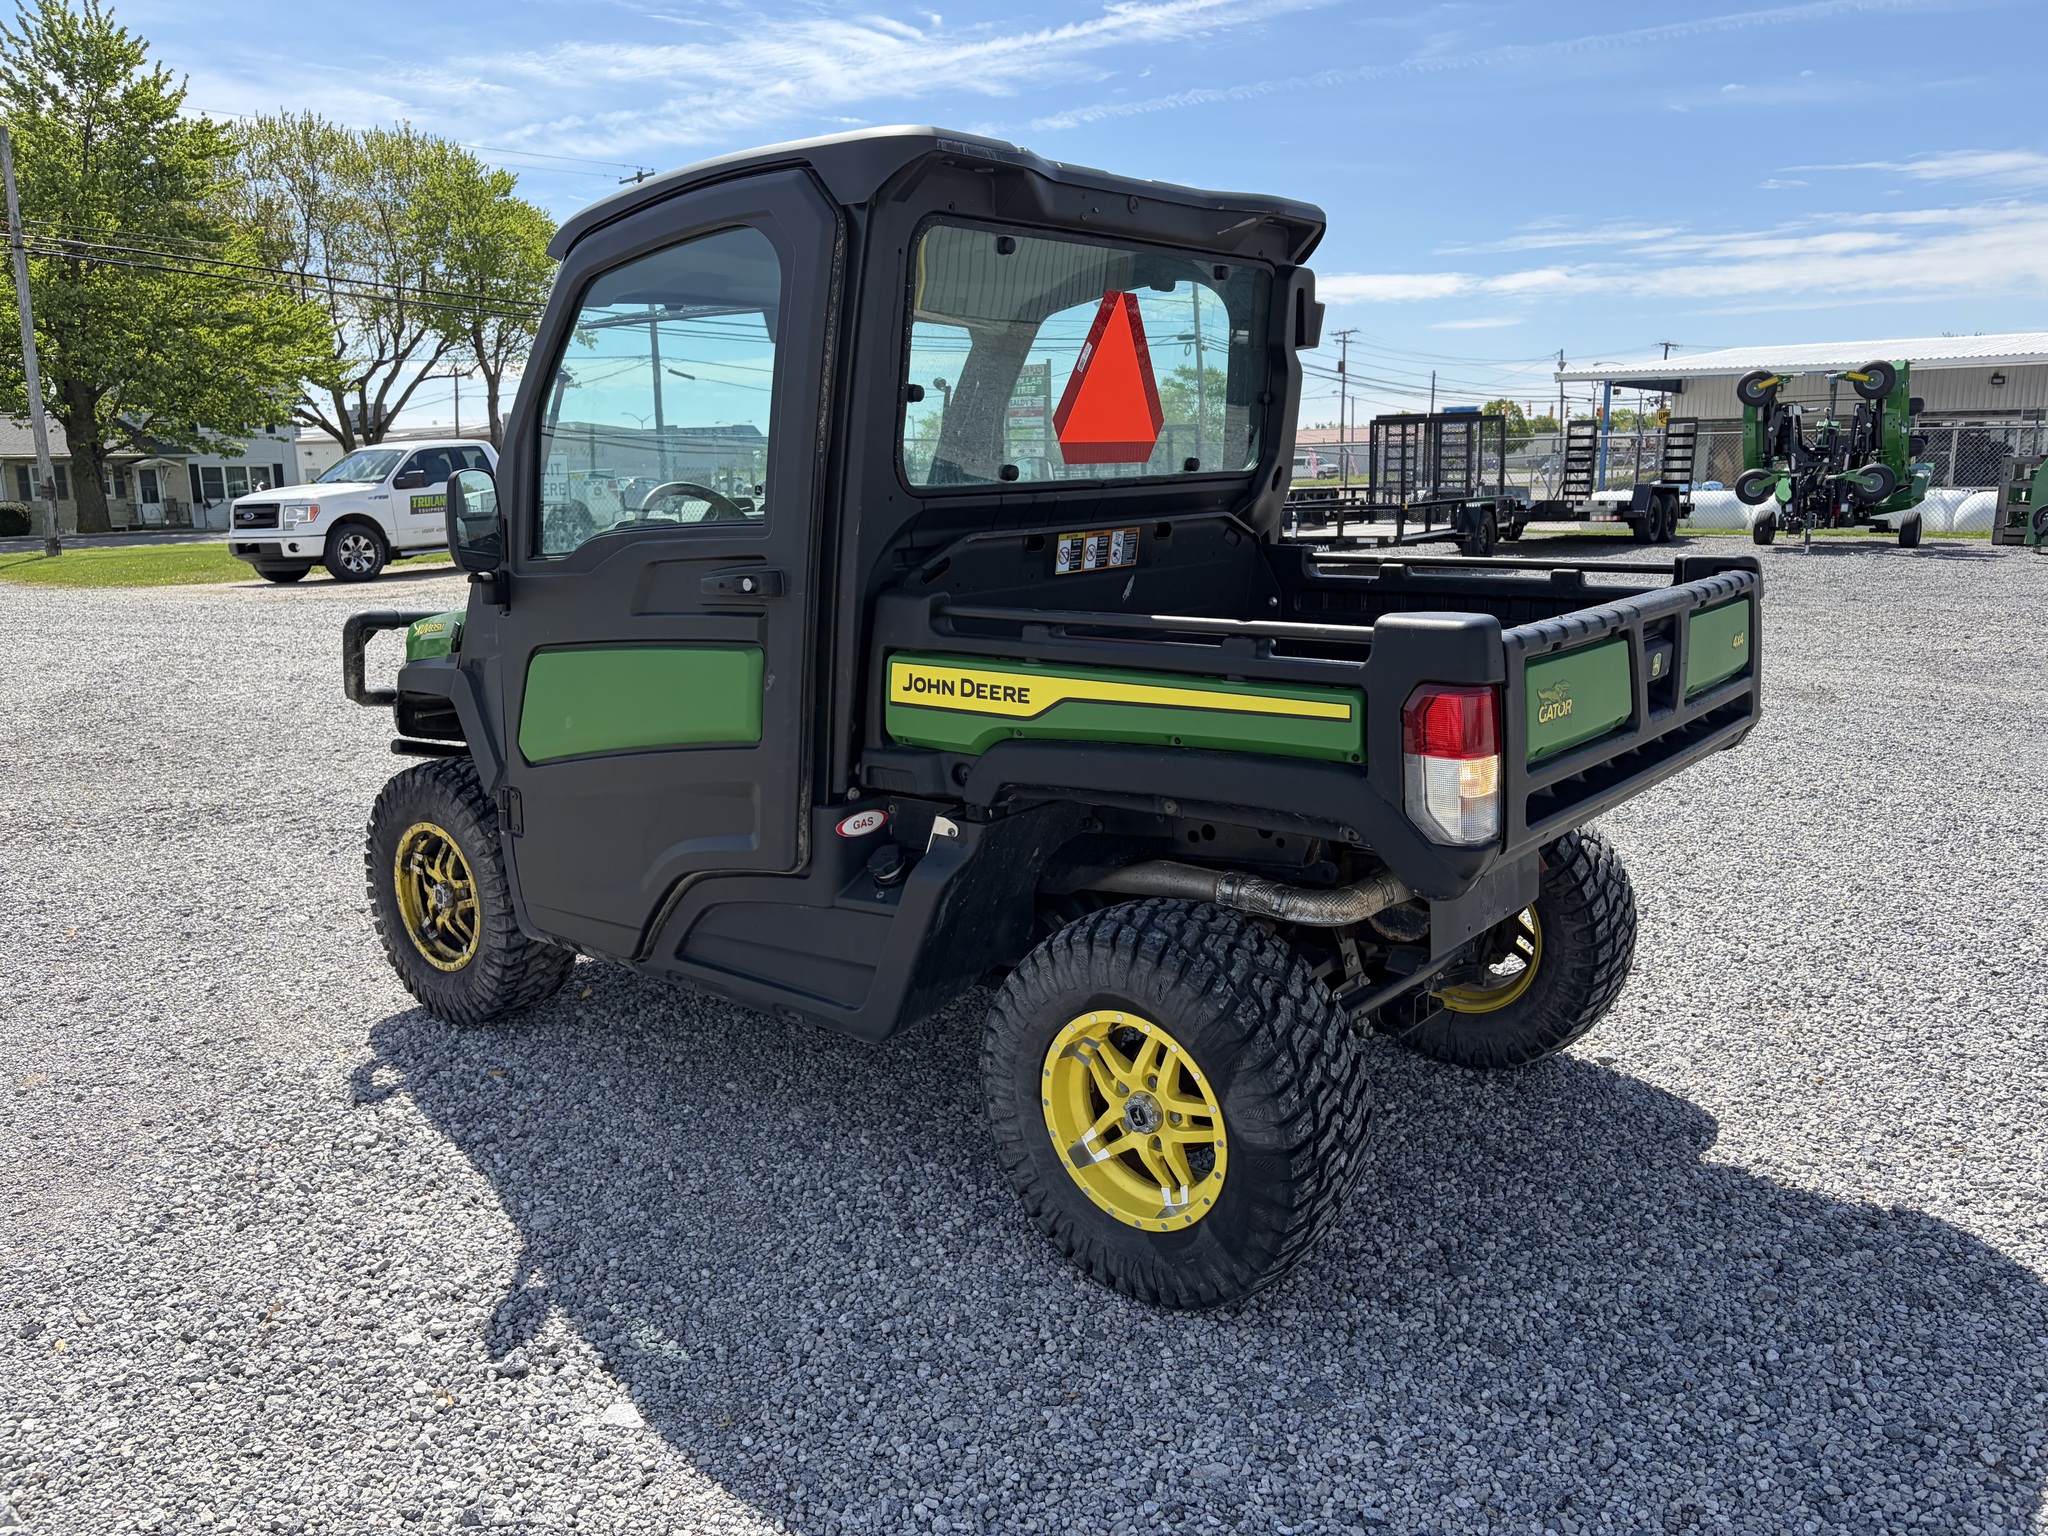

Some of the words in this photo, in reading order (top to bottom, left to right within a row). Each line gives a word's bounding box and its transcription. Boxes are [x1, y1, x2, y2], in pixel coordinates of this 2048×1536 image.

[1016, 376, 1042, 385] OLLAR
[1016, 385, 1036, 395] TREE
[546, 463, 562, 477] IT
[543, 482, 567, 496] ERE
[412, 494, 446, 508] TRULAN
[903, 673, 955, 697] JOHN
[961, 678, 1030, 704] DEERE
[1538, 699, 1573, 724] GATOR
[853, 816, 874, 830] GAS
